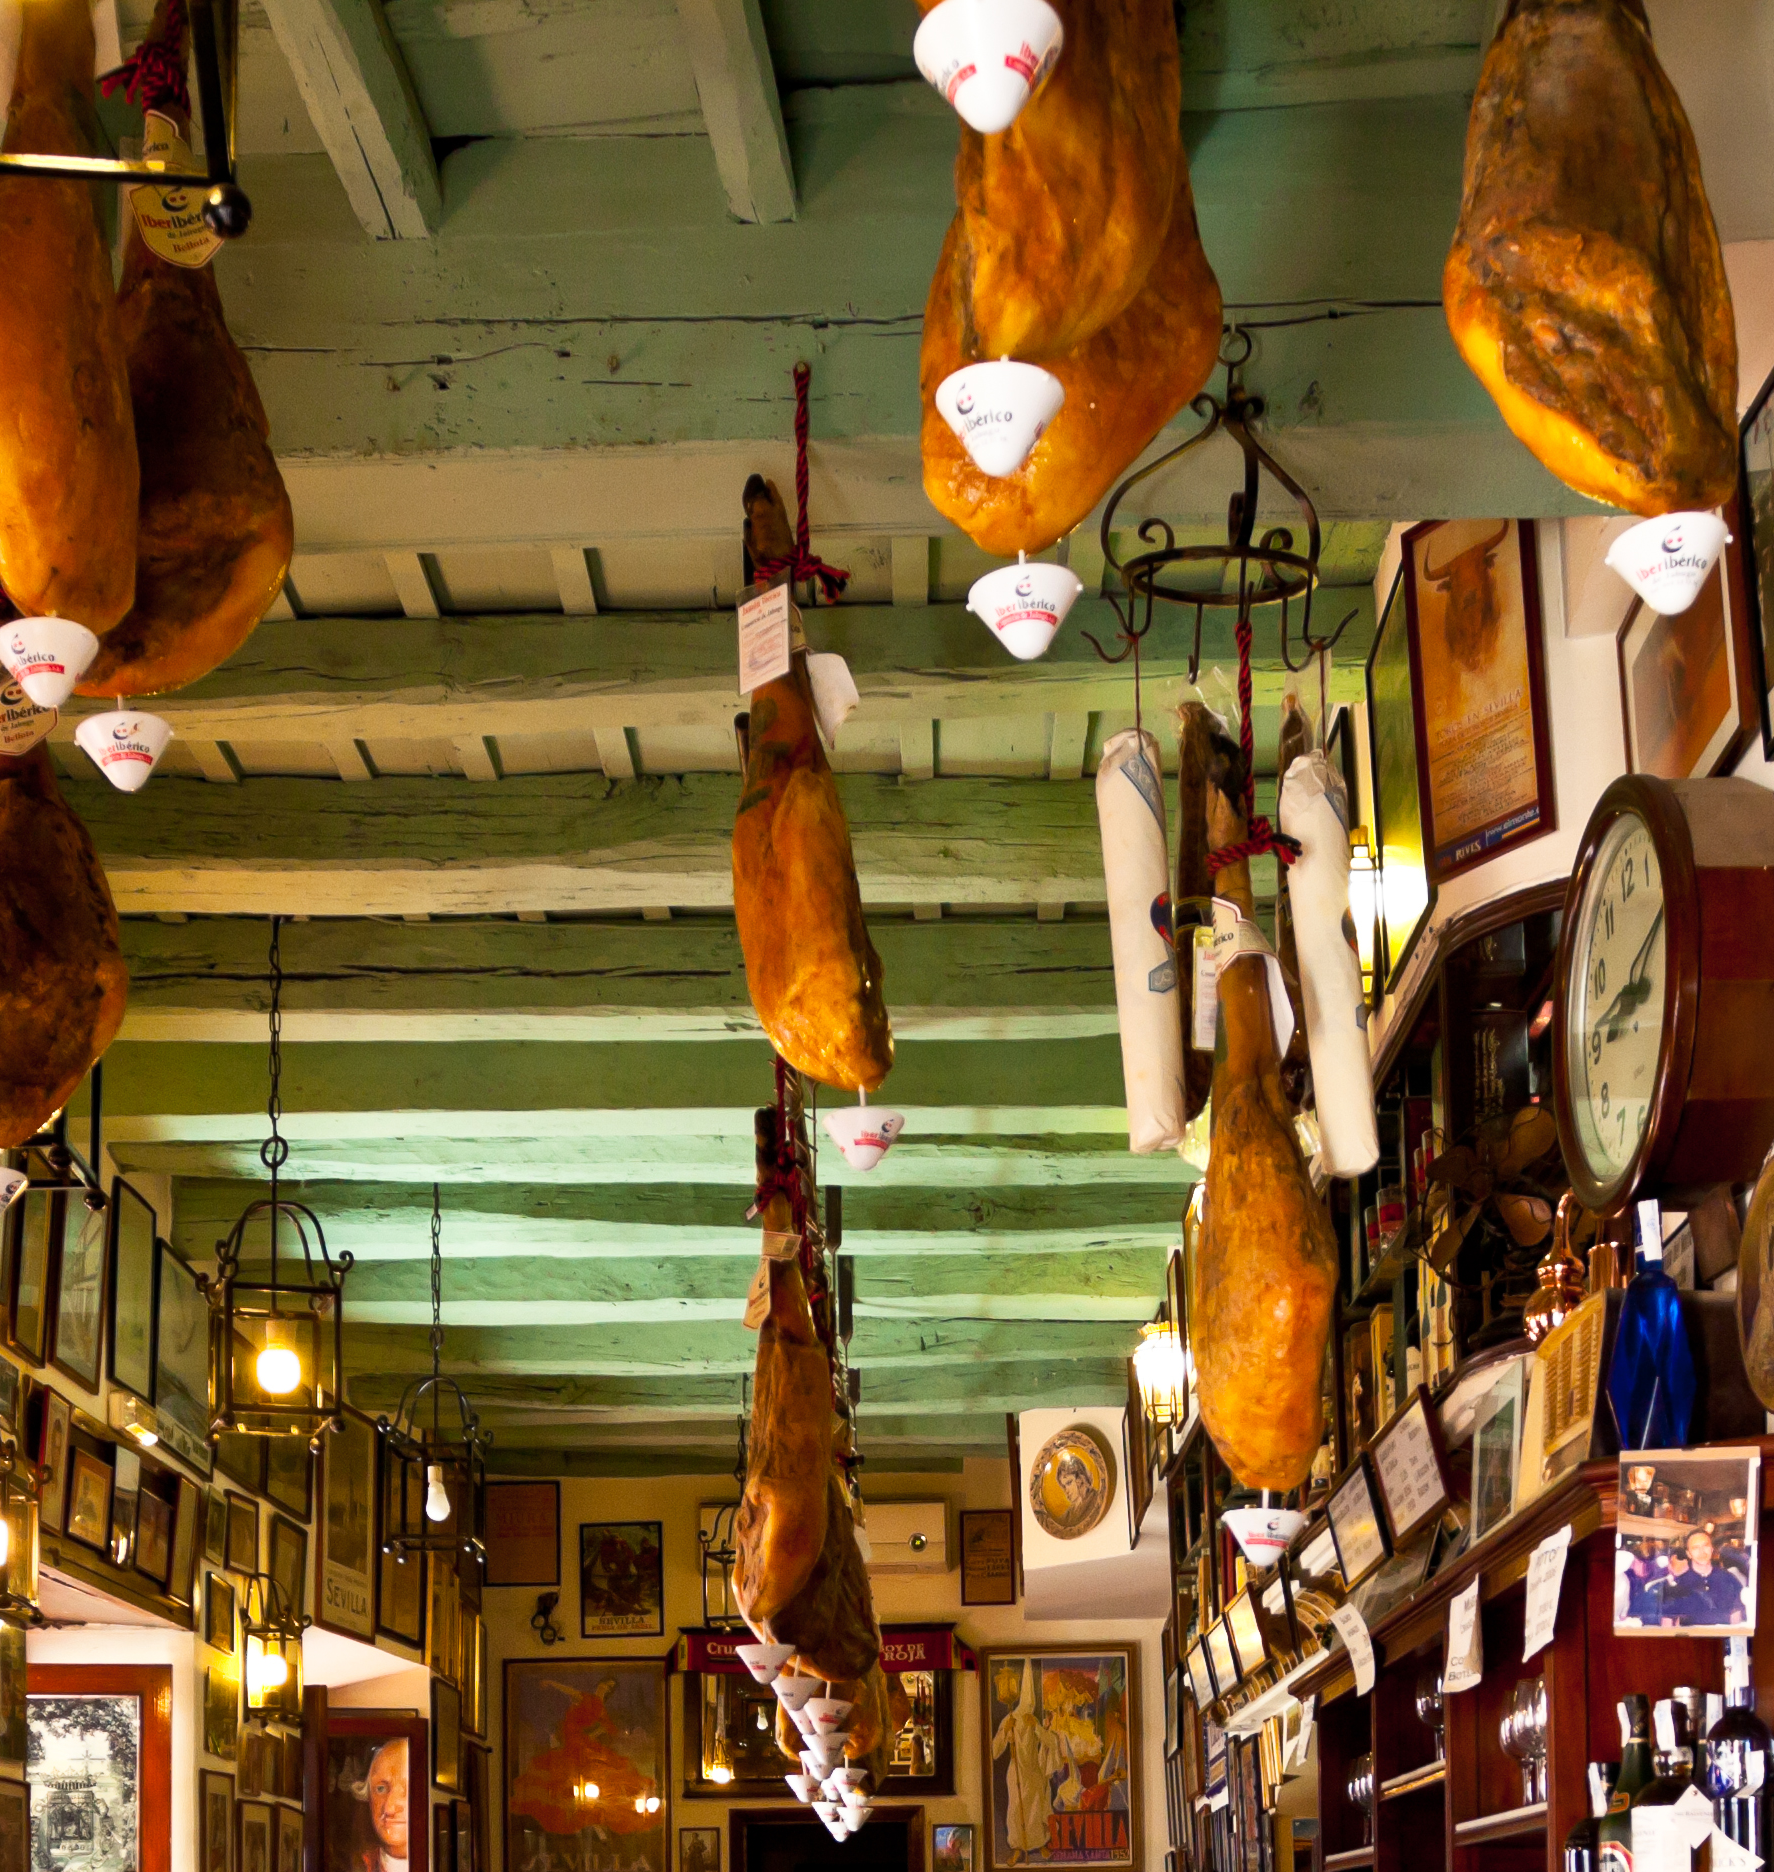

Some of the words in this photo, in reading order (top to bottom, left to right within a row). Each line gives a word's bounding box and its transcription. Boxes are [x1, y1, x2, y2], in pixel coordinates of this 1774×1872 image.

[1455, 839, 1482, 862] RIVES
[1620, 853, 1635, 904] 12
[1047, 1812, 1128, 1849] SEVILLA
